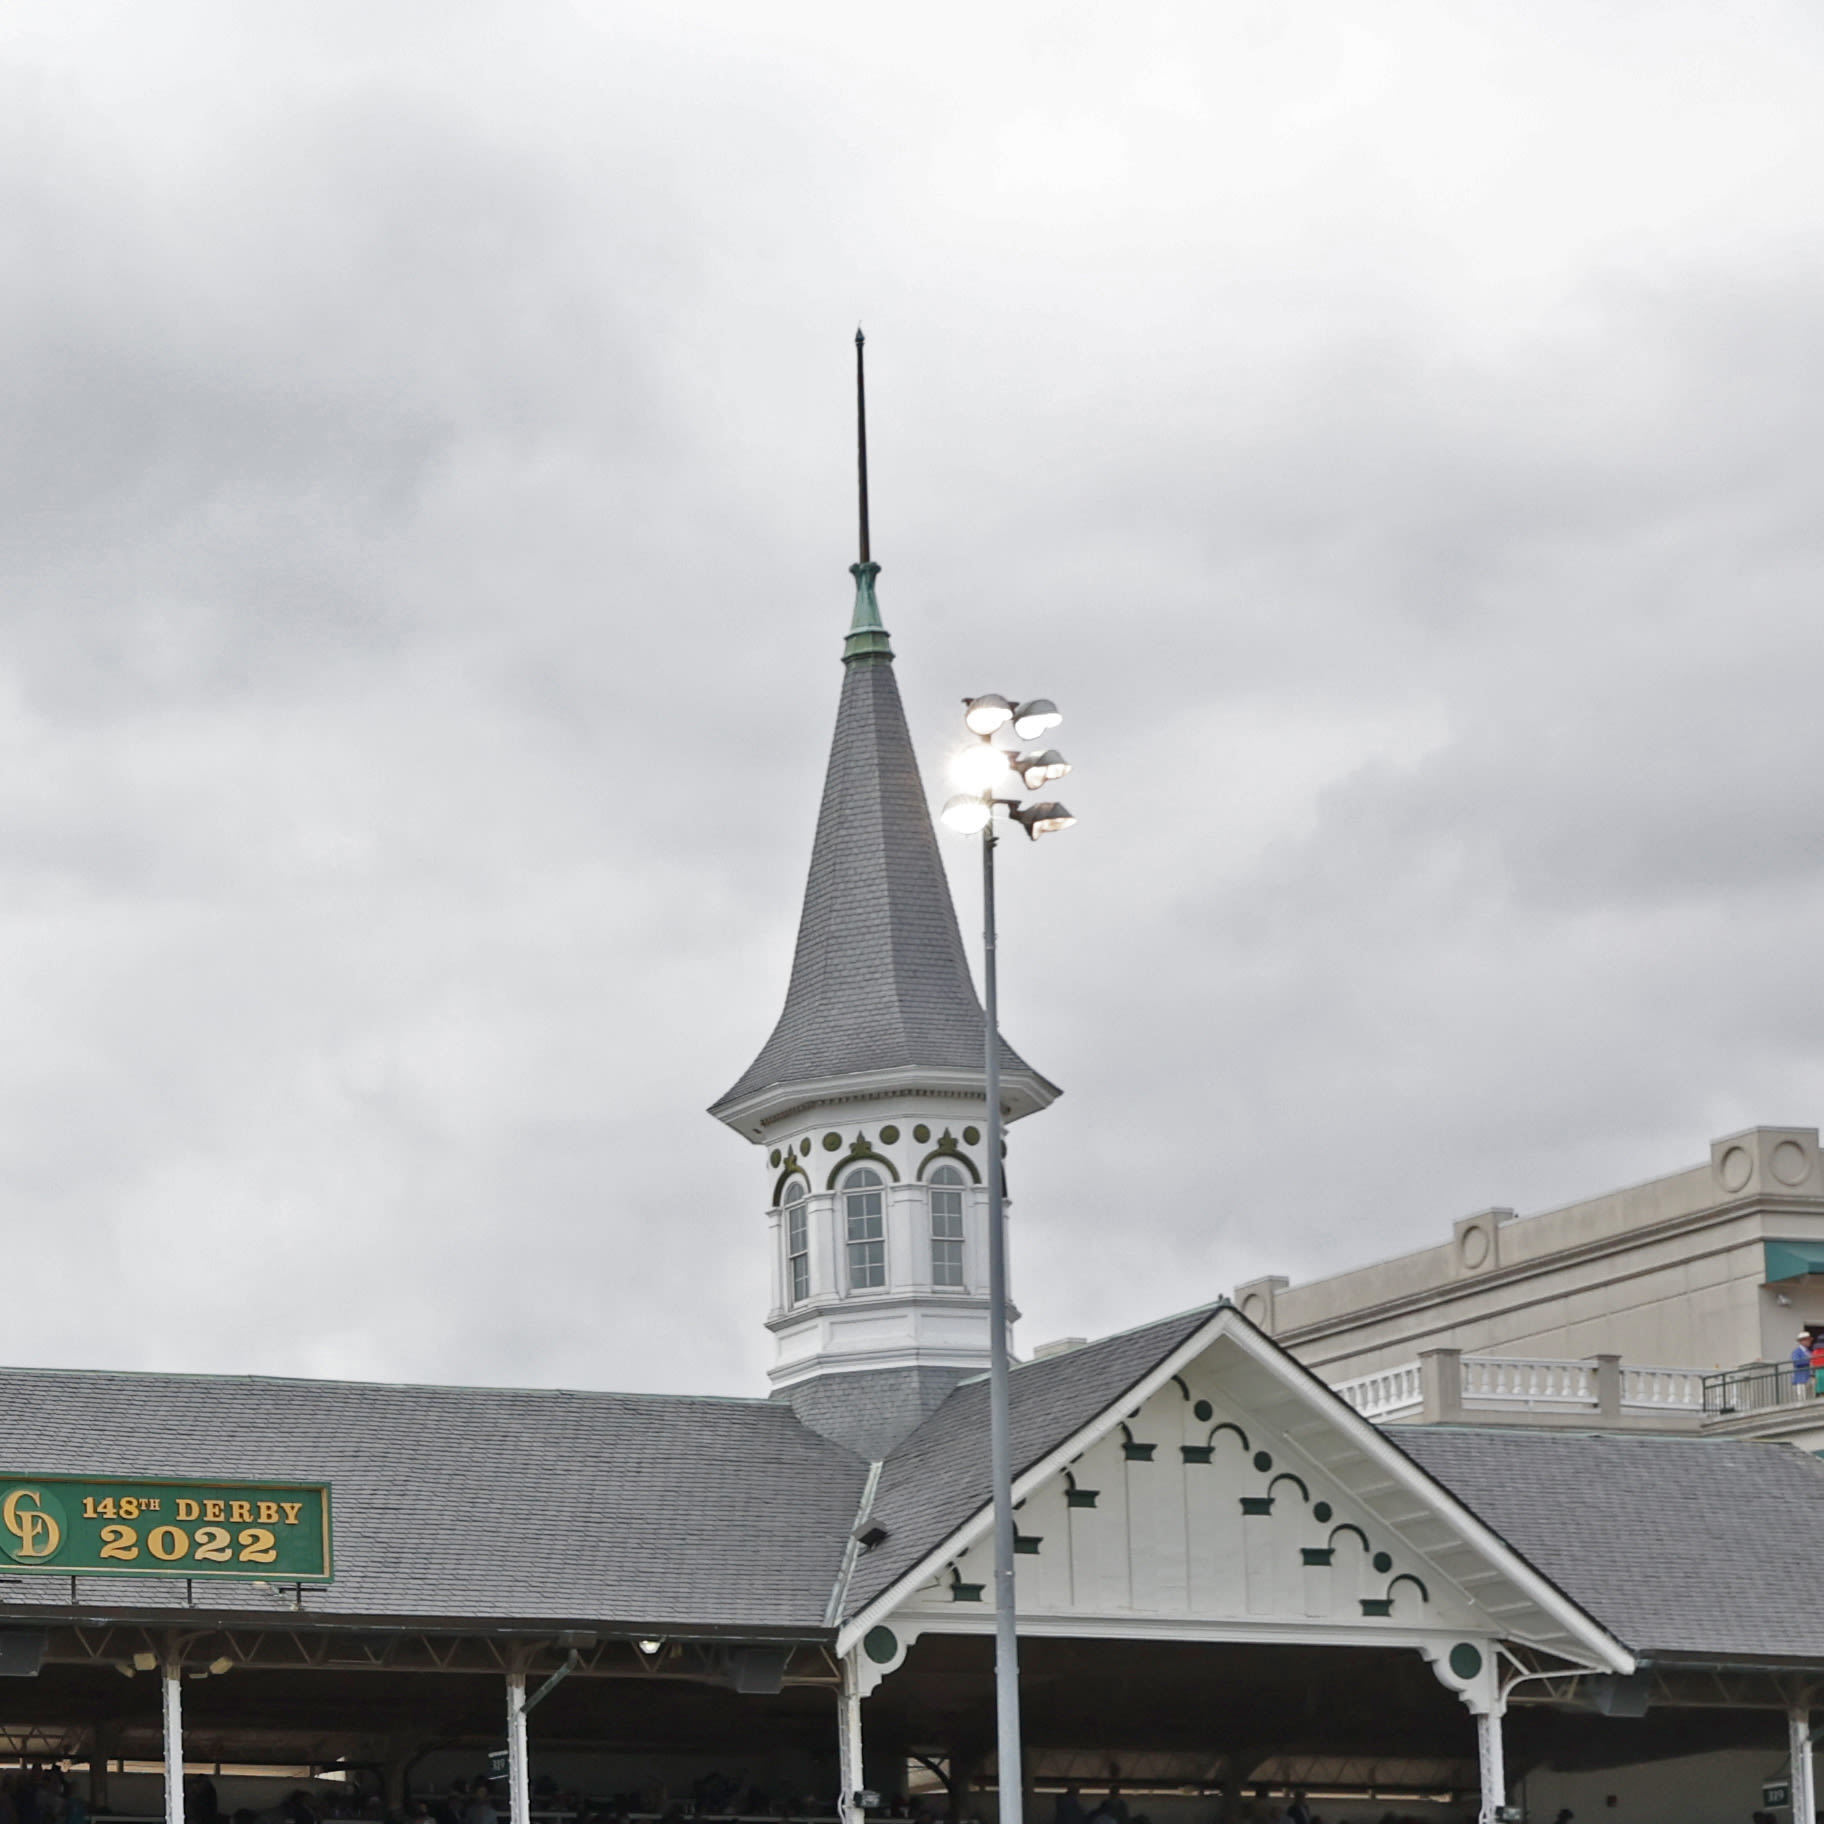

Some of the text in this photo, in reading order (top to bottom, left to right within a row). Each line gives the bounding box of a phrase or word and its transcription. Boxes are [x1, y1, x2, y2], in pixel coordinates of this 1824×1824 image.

[83, 1496, 303, 1524] 148TH DERBY
[99, 1524, 278, 1563] 2022
